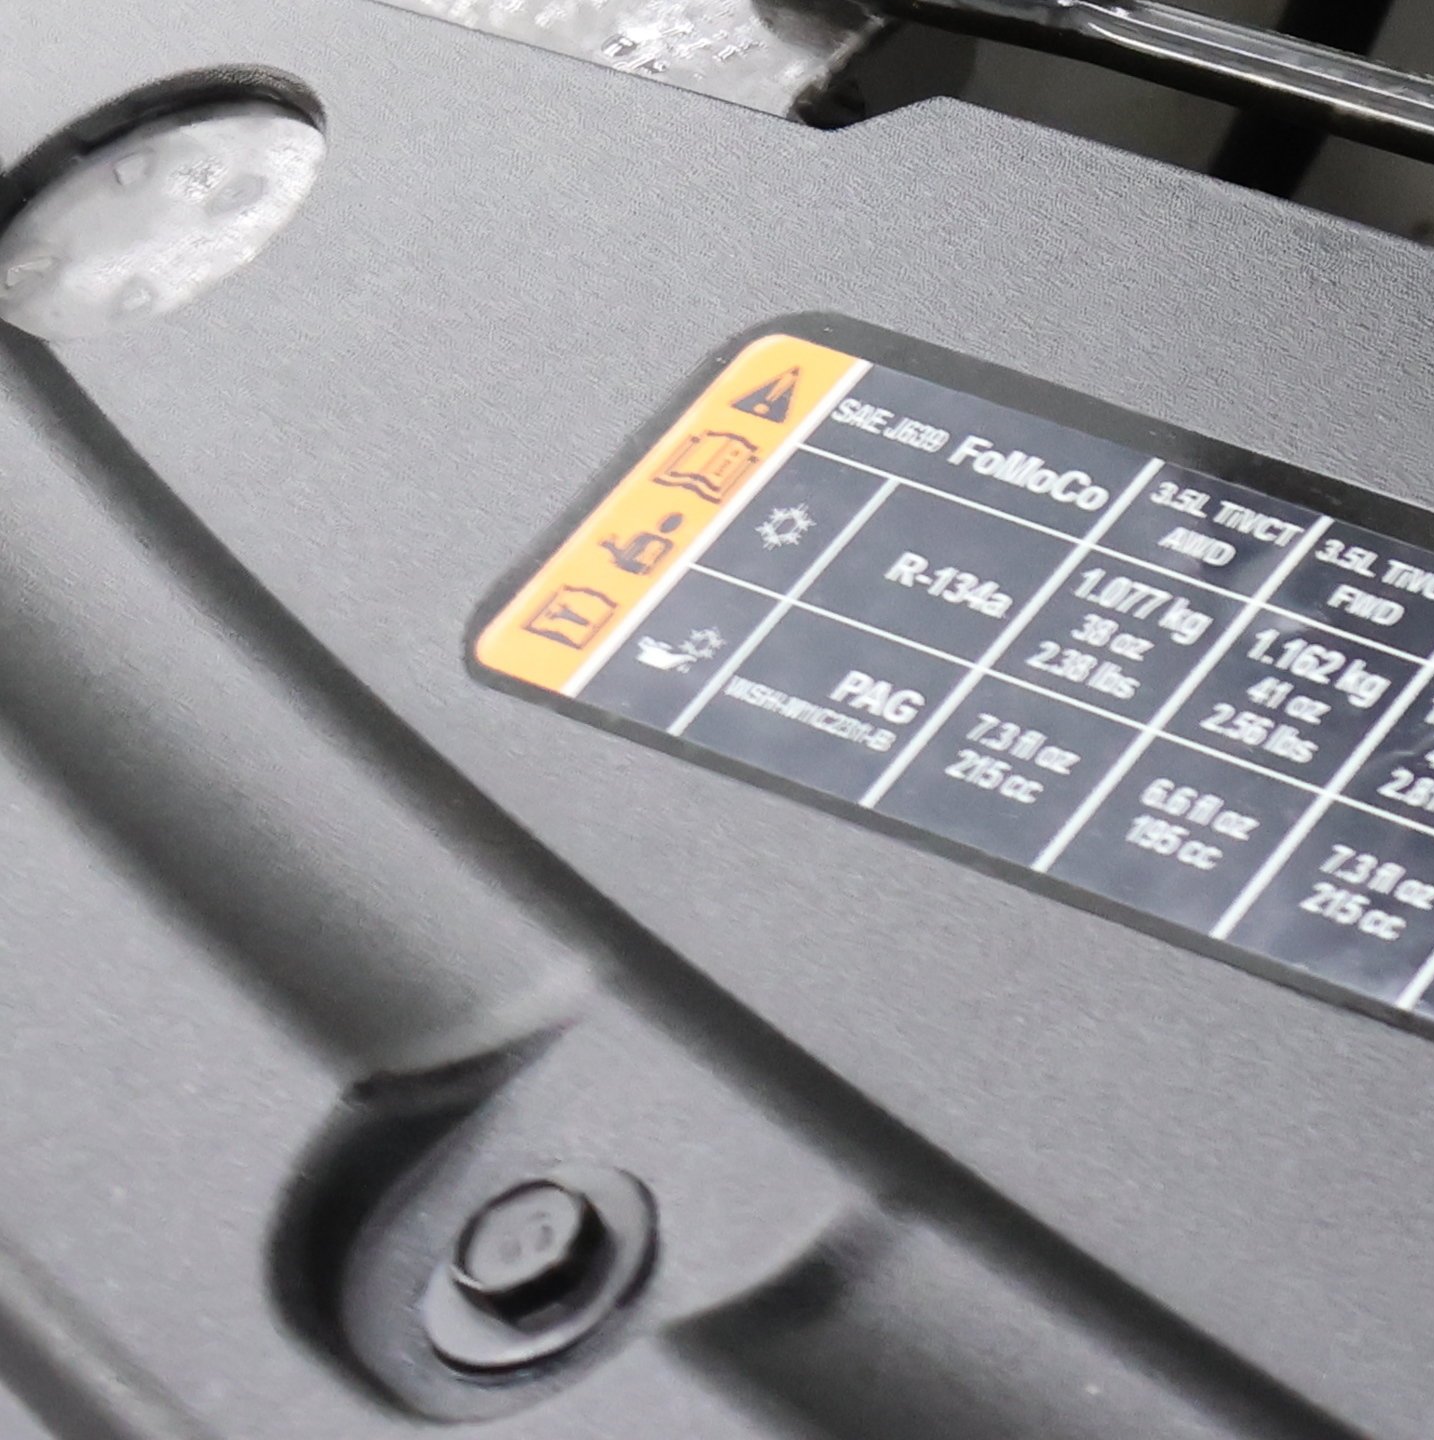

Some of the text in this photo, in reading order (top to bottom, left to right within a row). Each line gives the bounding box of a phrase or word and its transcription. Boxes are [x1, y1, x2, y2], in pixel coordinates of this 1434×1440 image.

[830, 398, 1110, 511] SAE J639 FoMoCo
[1150, 482, 1211, 518] 3.5L
[1157, 526, 1237, 566] AWD
[1315, 539, 1379, 577] 3.5L
[884, 551, 1013, 619] R-134a
[1327, 584, 1405, 626] FWD
[1074, 568, 1213, 645] 1.077 kg
[1109, 634, 1155, 661] oz
[1088, 662, 1140, 700] lbs
[1247, 629, 1392, 708] 1.162 kg
[828, 670, 925, 724] PAG
[1247, 676, 1332, 725] 41 oz
[1034, 746, 1081, 775] oz
[1263, 724, 1319, 763] lbs
[944, 749, 1044, 804] 215 cc
[1211, 810, 1260, 841] oz
[1177, 840, 1223, 870] cc
[1299, 881, 1407, 941] 215 cc
